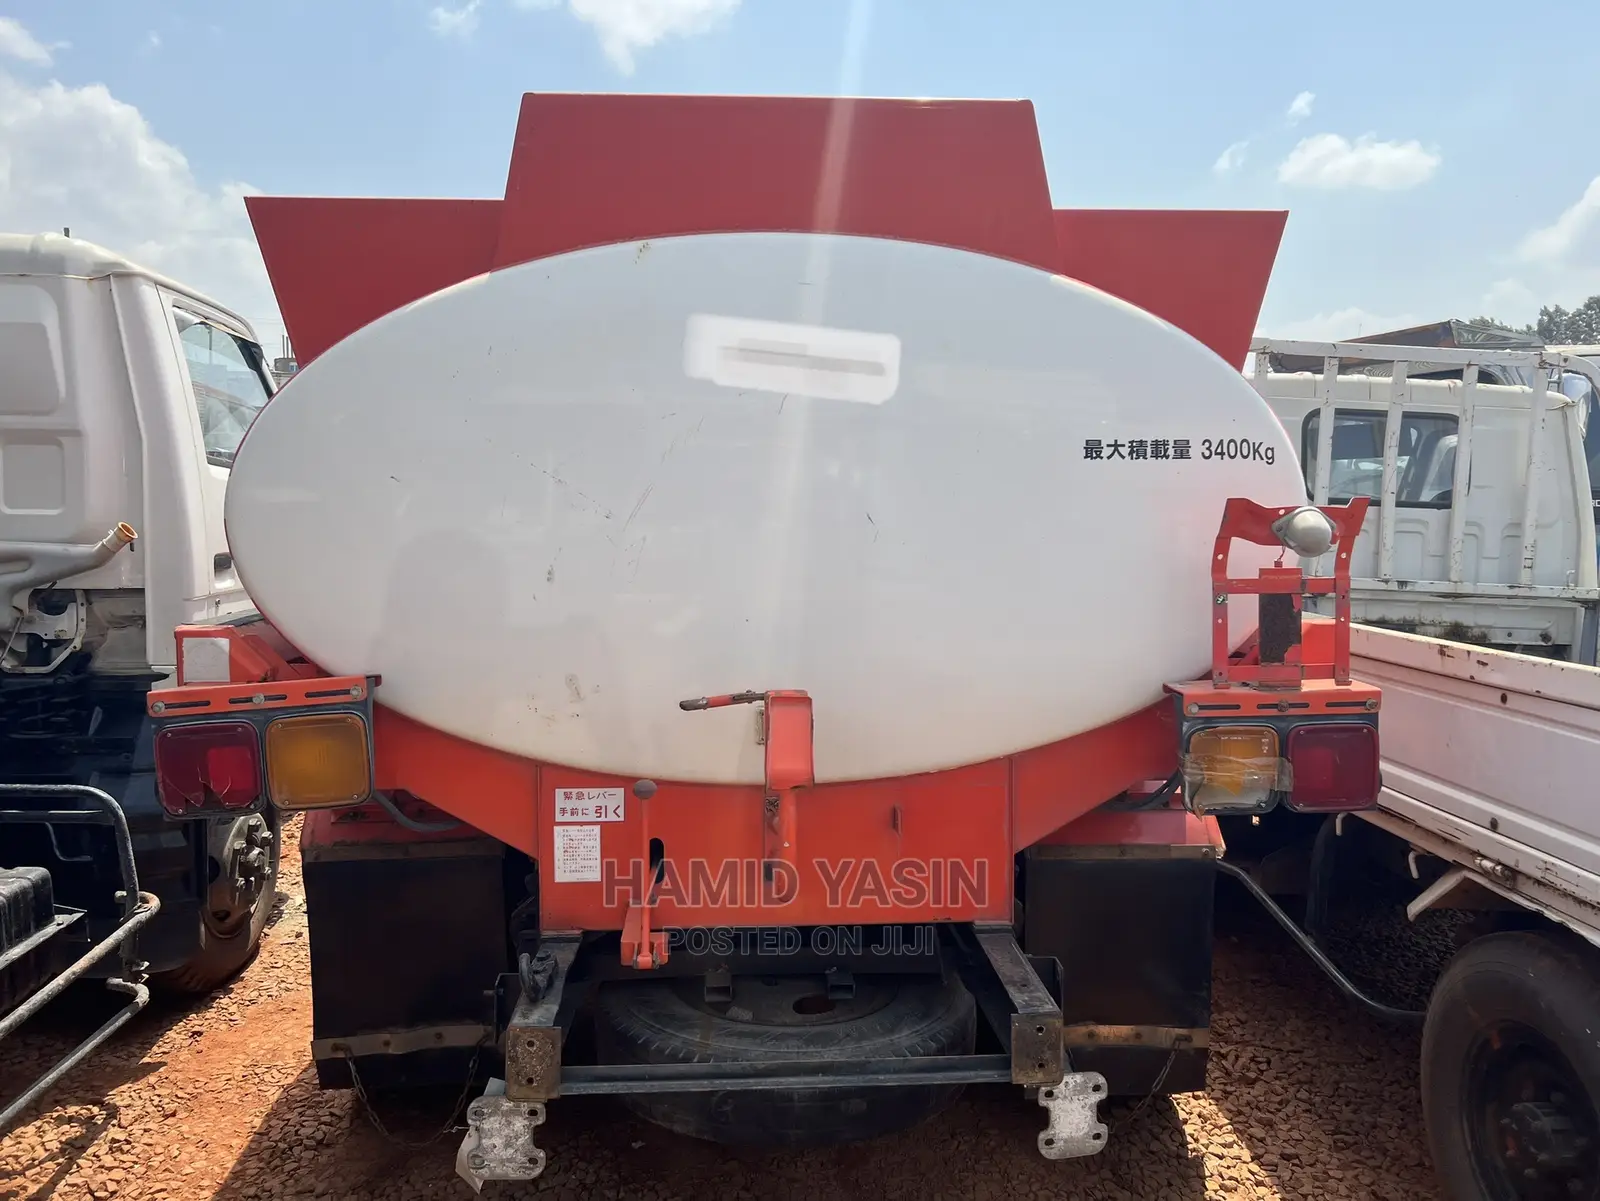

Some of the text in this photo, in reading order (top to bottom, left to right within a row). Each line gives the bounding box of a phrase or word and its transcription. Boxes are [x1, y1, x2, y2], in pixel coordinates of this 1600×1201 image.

[1083, 438, 1276, 465] 最大積載量 3400Kg
[563, 790, 617, 801] 緊急レバー
